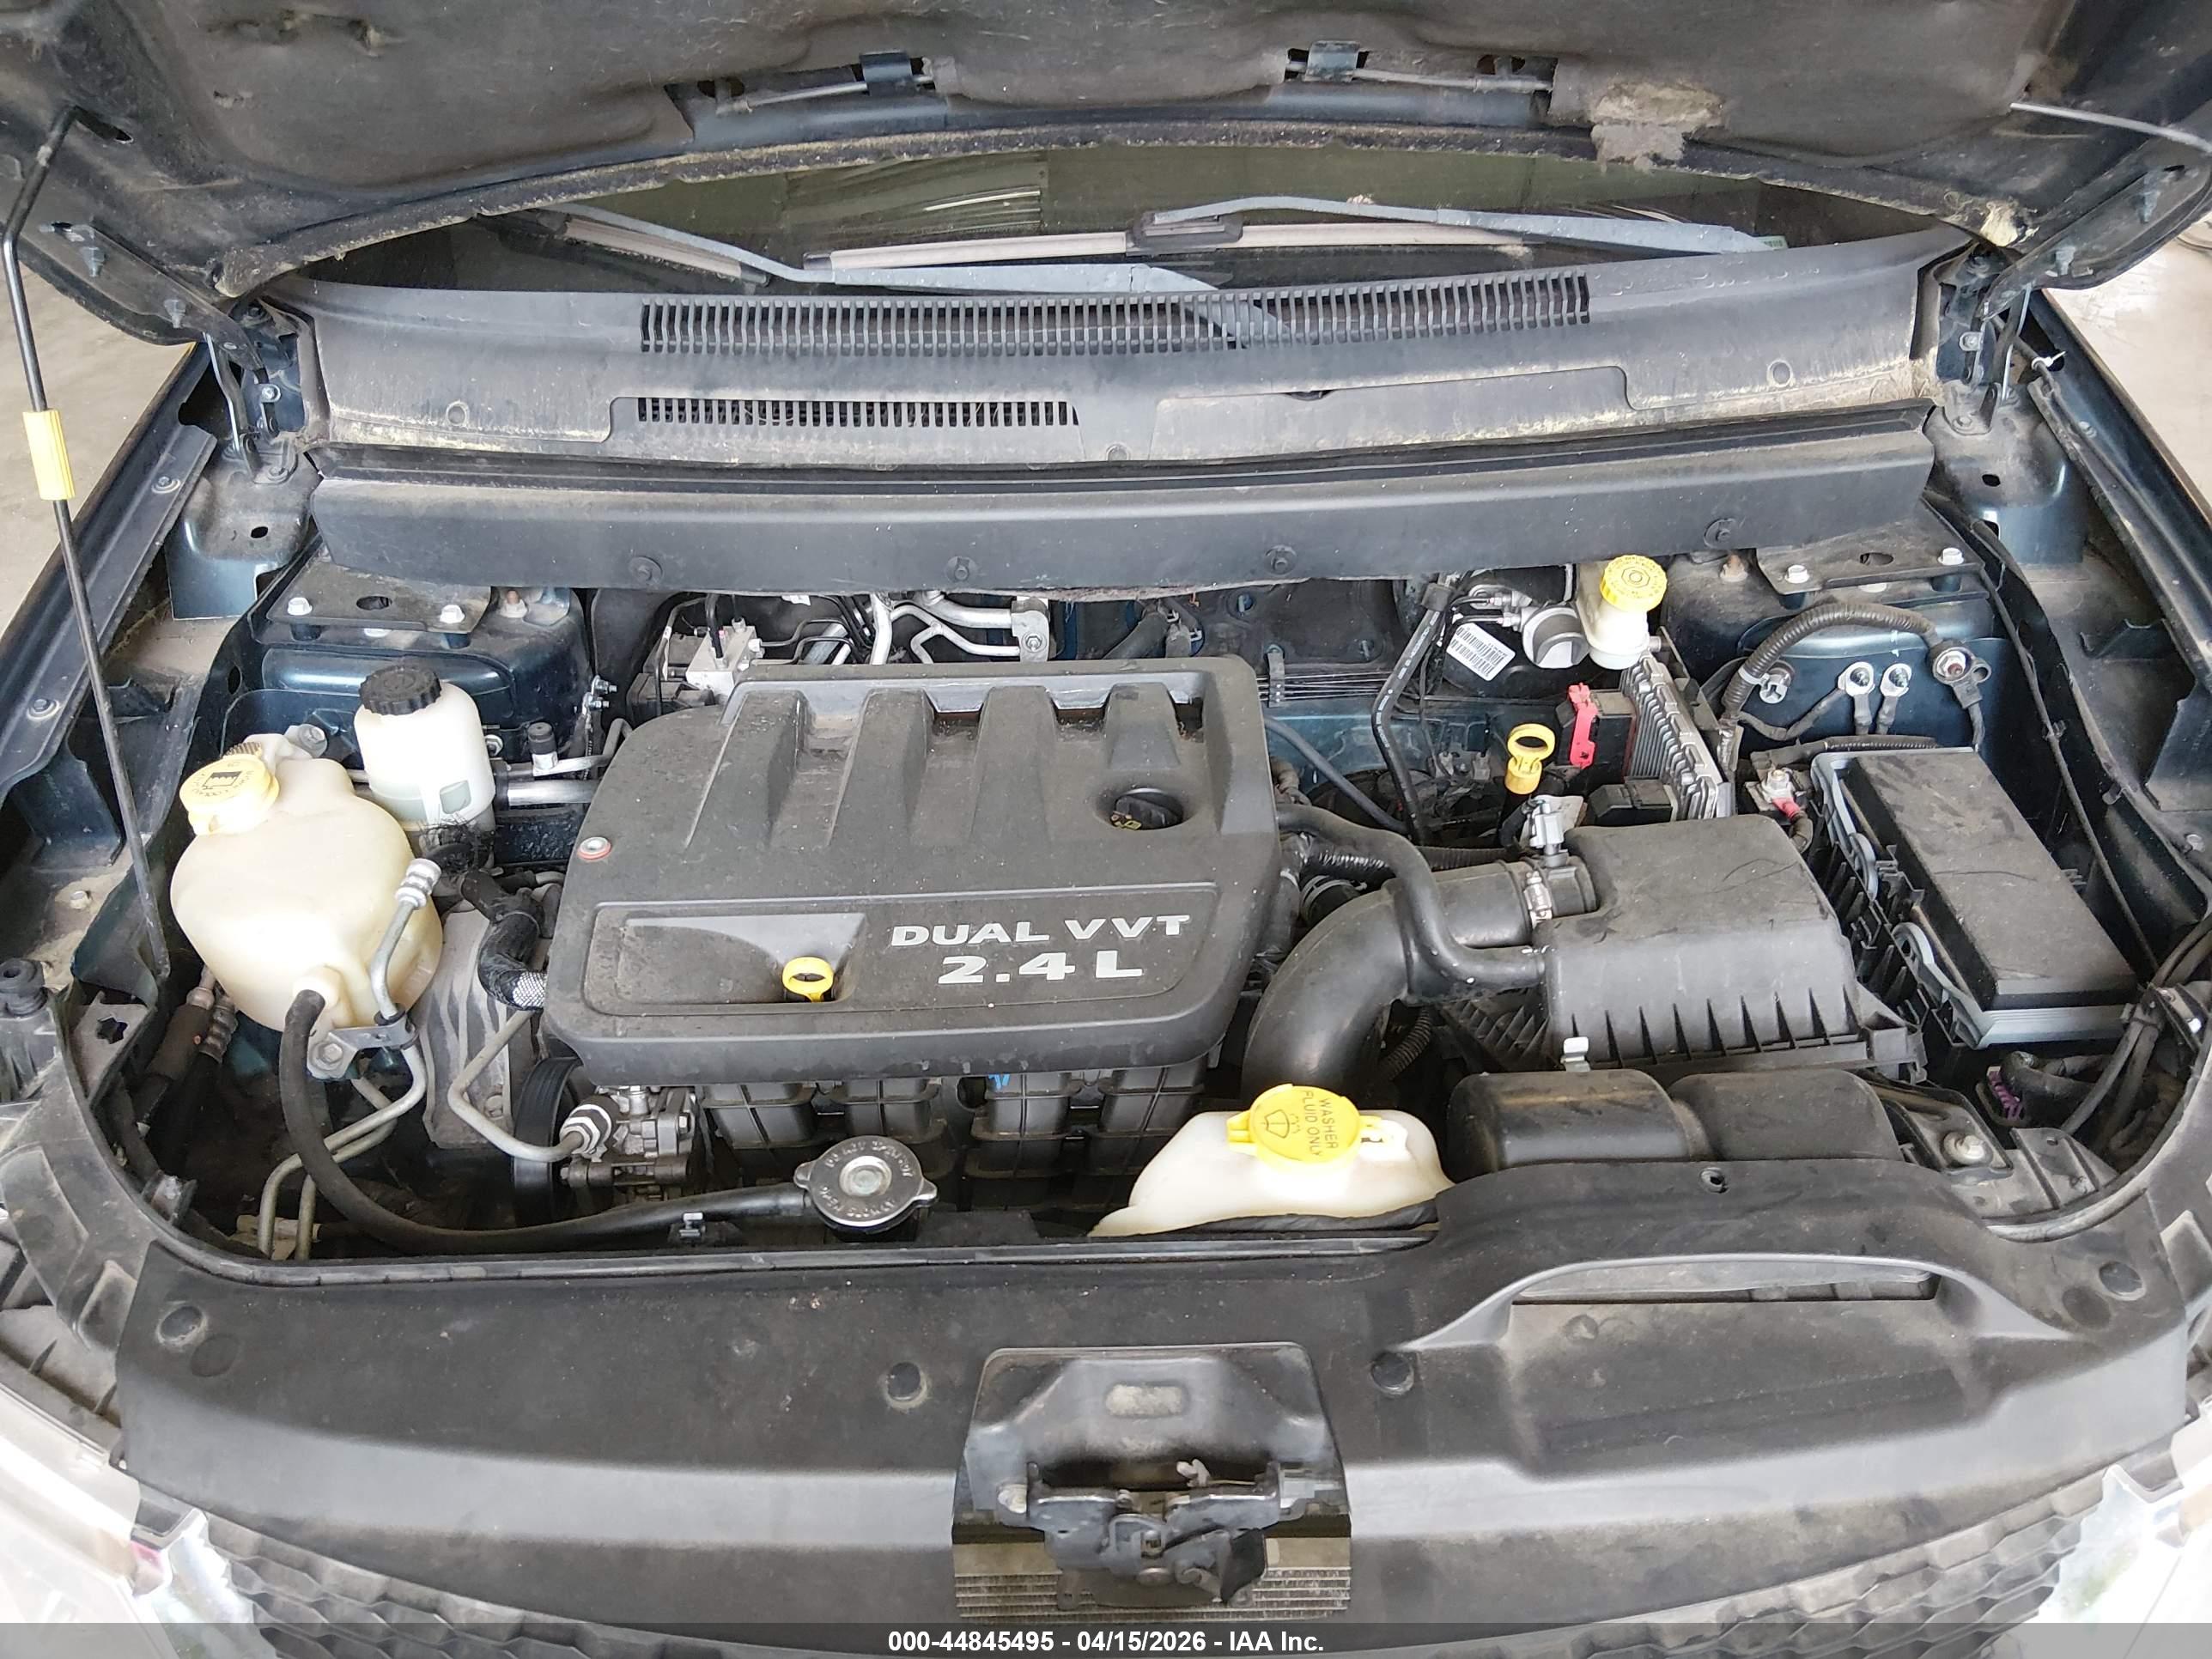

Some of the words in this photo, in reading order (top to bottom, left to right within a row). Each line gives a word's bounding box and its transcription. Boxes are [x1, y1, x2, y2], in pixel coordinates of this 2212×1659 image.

[891, 921, 1049, 946] DUAL
[1064, 915, 1190, 940] VVT
[1302, 1091, 1318, 1123] FLUID
[1319, 1098, 1339, 1149] WASHER
[1307, 1127, 1323, 1157] ONLY
